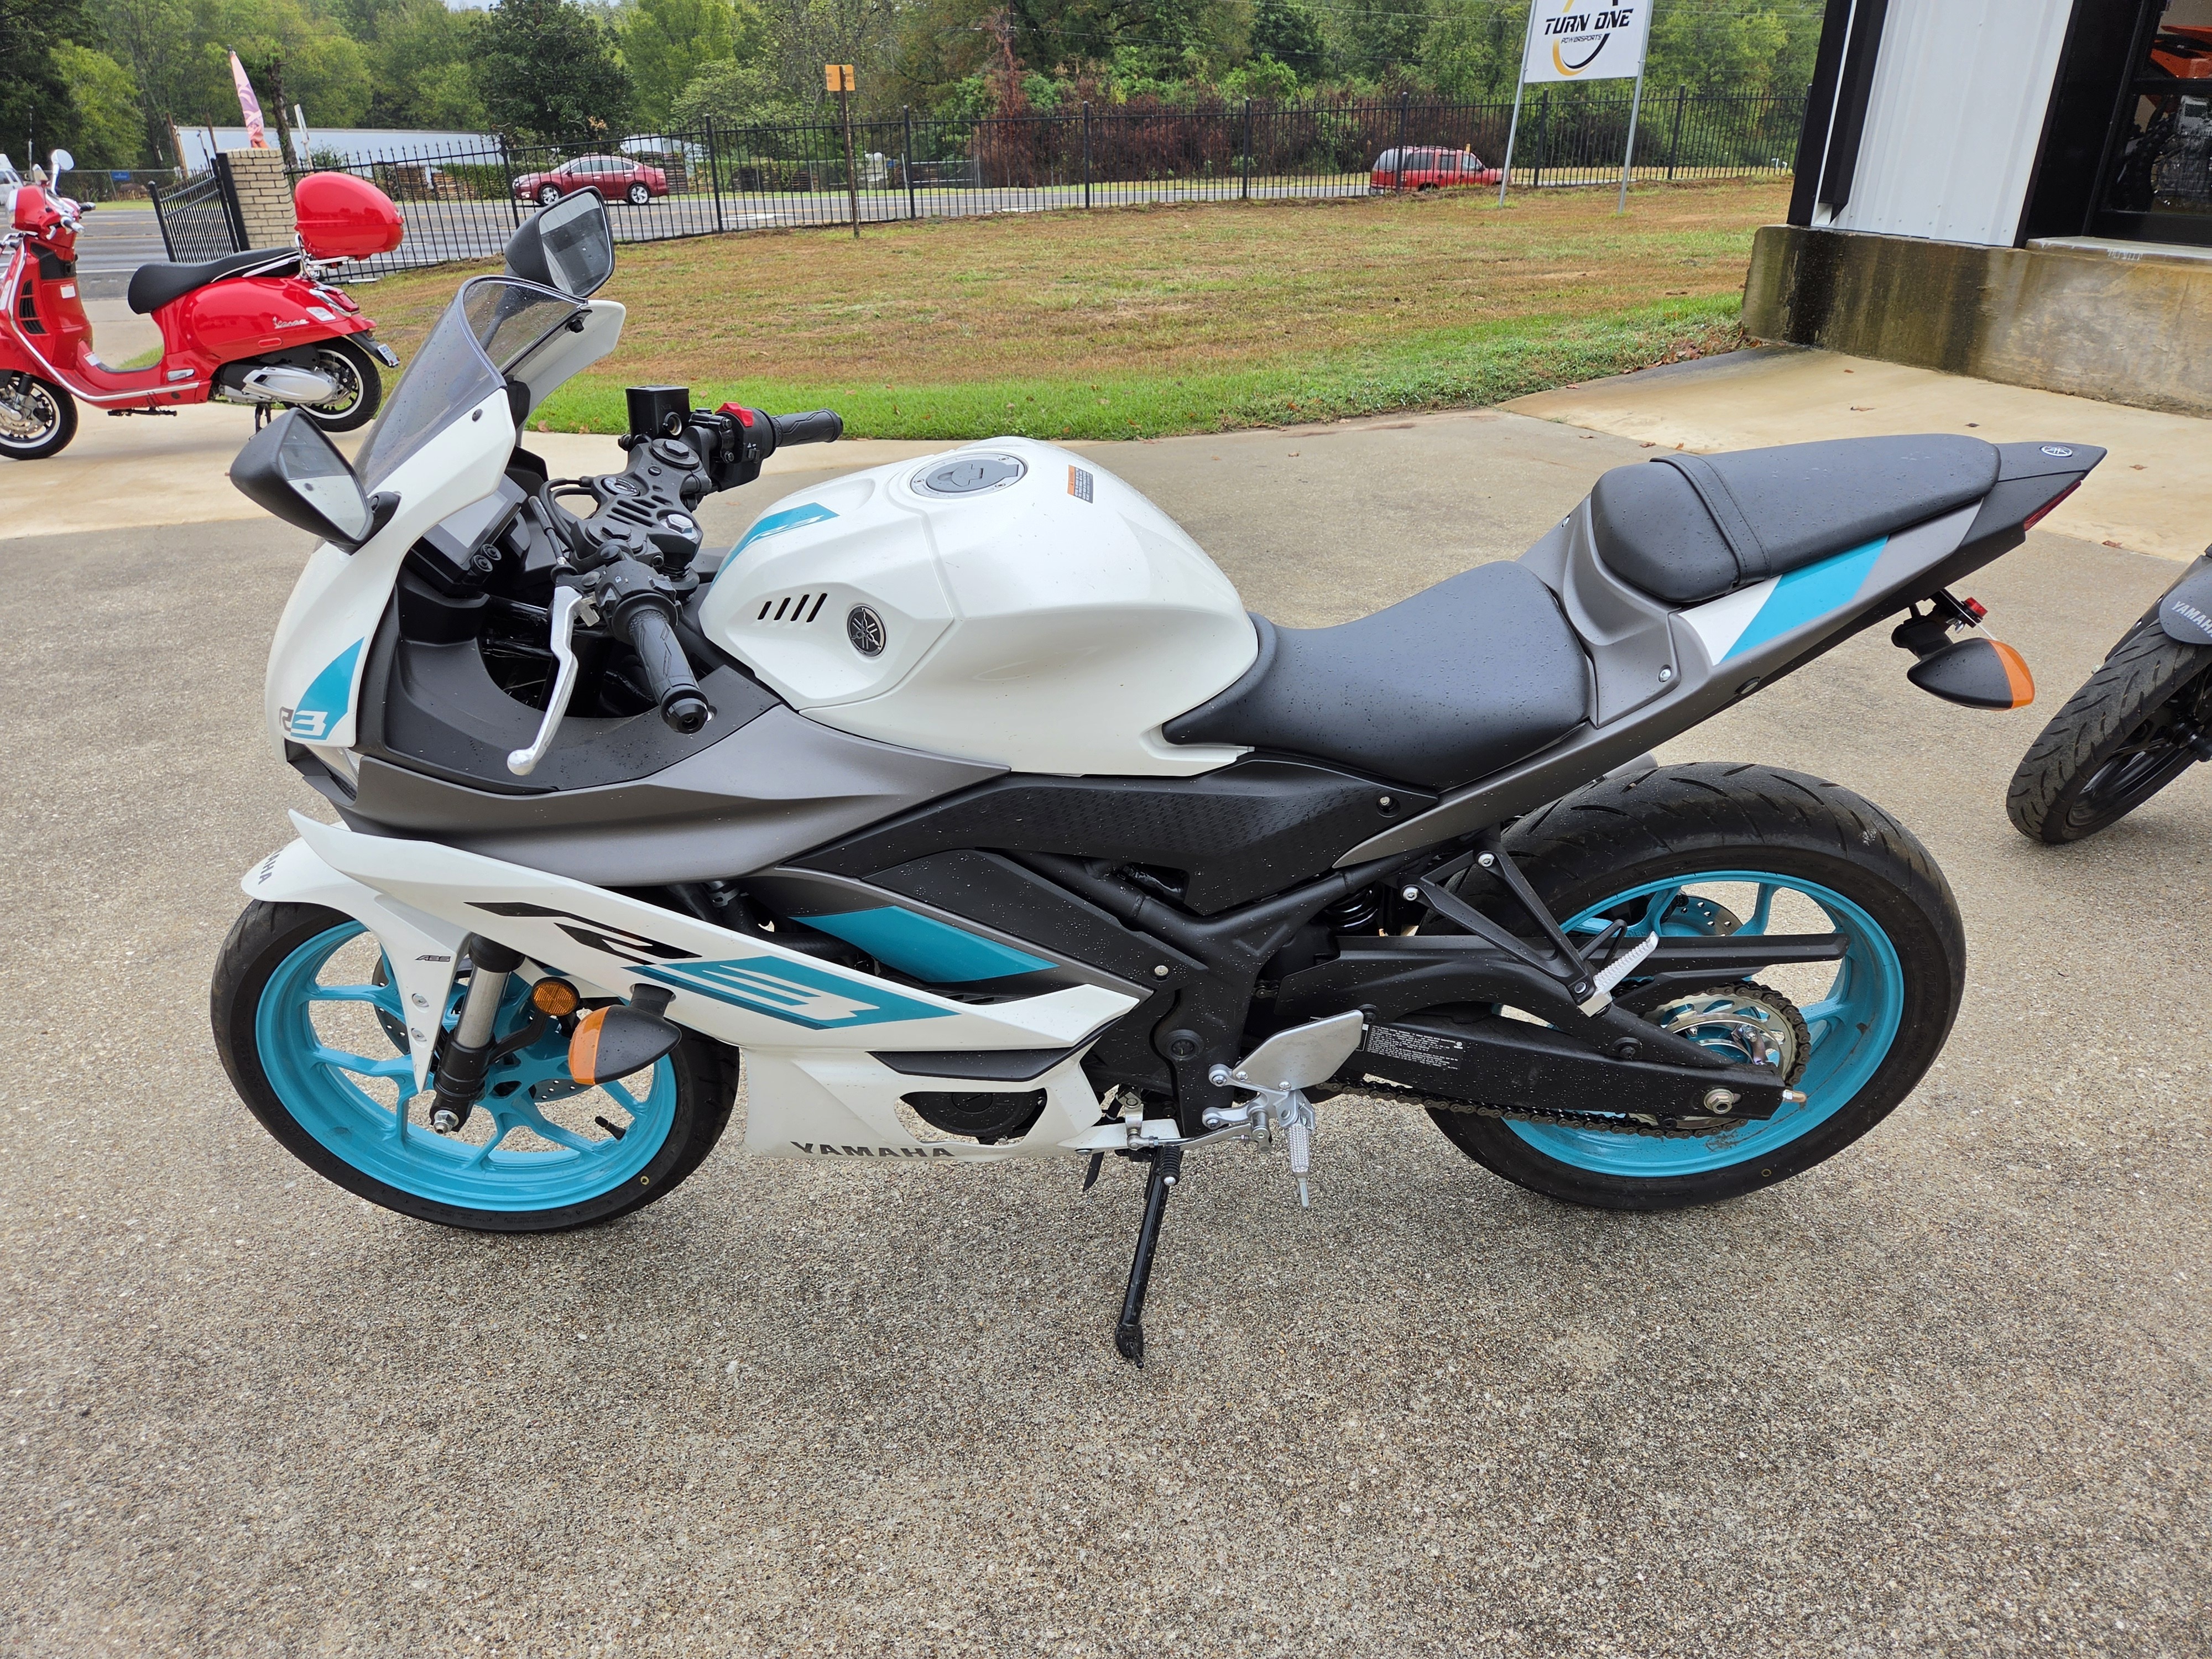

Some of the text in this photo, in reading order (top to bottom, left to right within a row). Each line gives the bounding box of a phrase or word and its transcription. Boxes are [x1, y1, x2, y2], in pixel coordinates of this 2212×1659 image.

[1545, 8, 1634, 35] TURN ONE
[1561, 34, 1603, 44] POWERSPORTS
[273, 316, 310, 329] Vespa
[790, 1141, 955, 1157] YAMAHA
